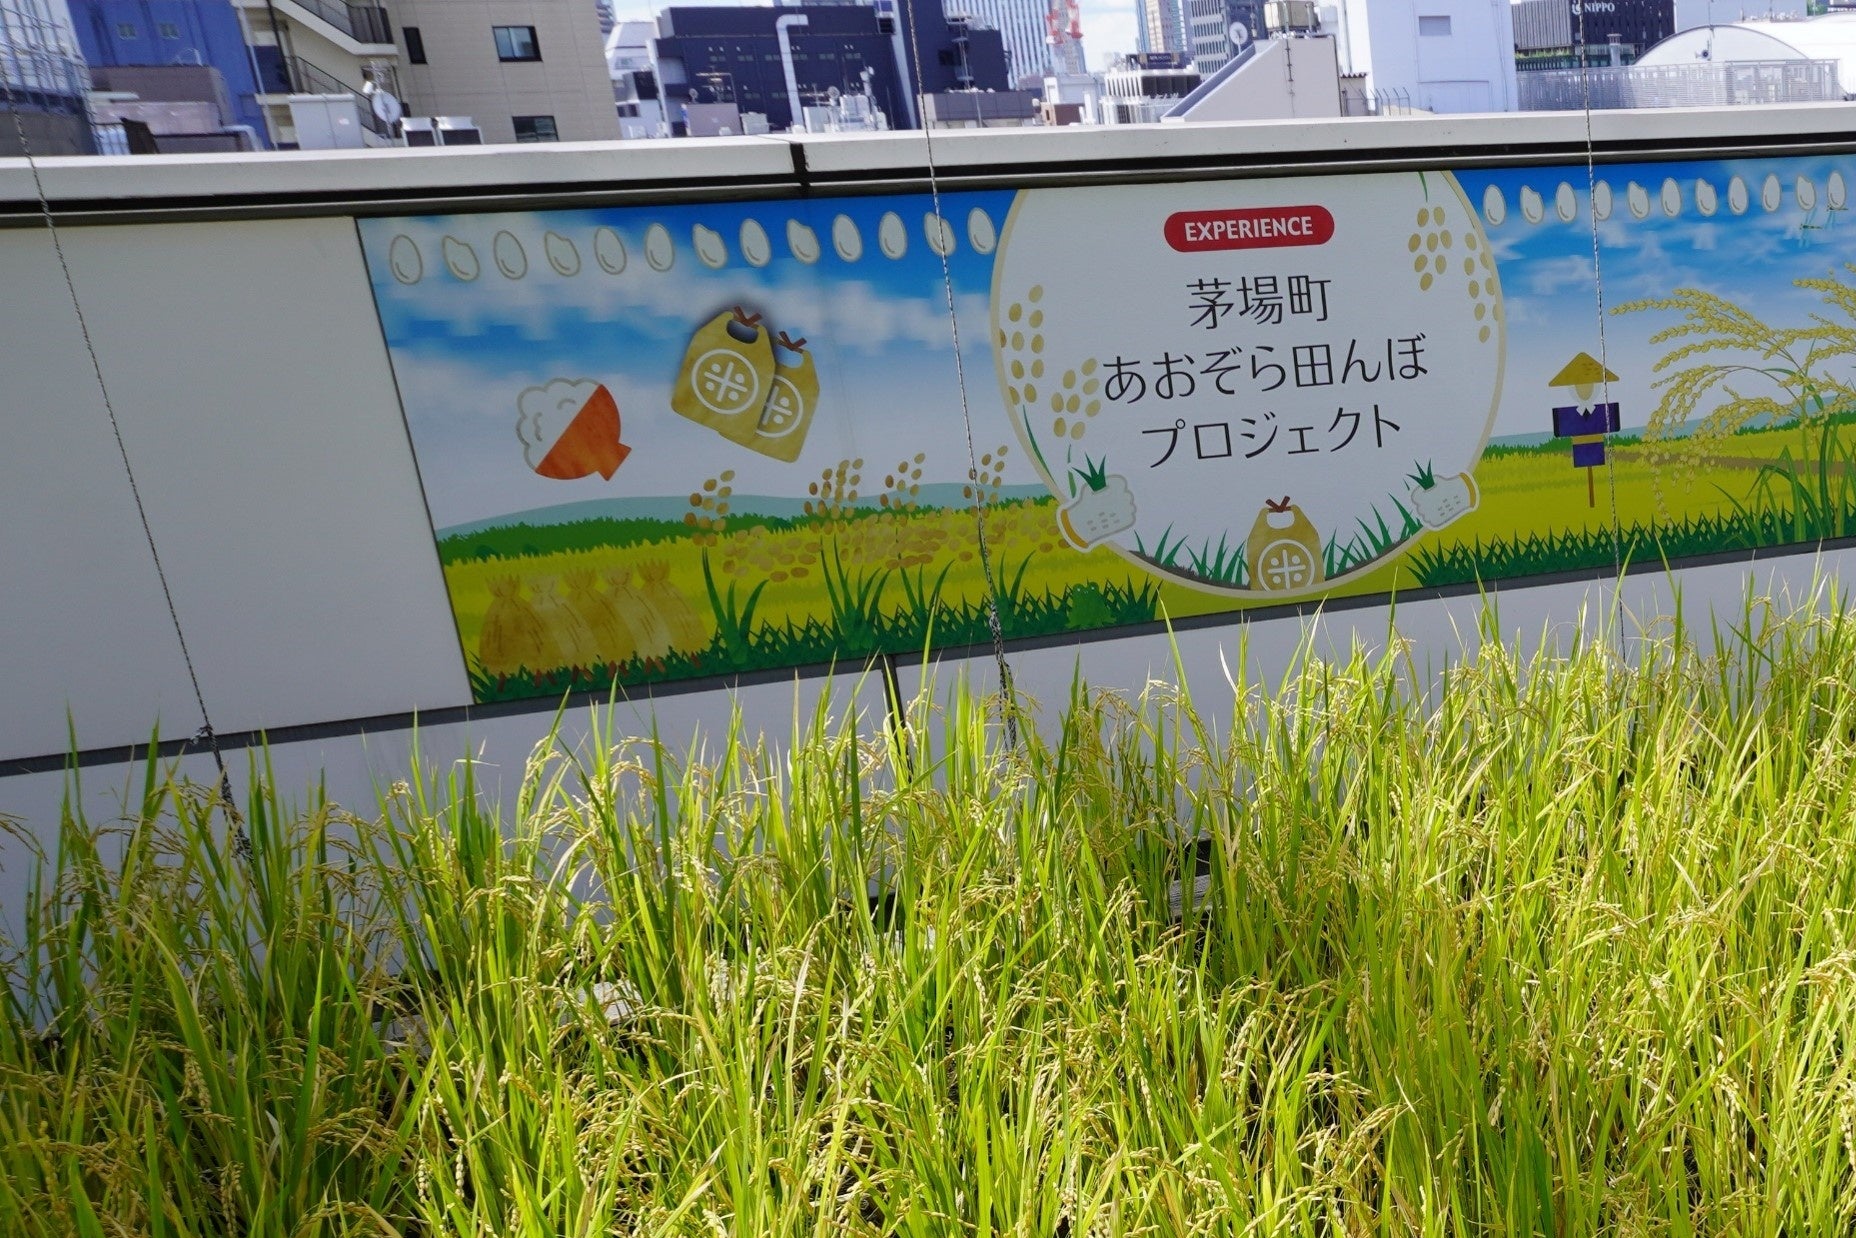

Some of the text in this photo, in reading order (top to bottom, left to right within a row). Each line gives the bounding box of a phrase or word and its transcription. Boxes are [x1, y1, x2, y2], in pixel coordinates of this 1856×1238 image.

[1584, 2, 1616, 13] NIPPO
[1184, 216, 1314, 242] EXPERIENCE
[1186, 275, 1332, 330] 茅場町
[1102, 332, 1428, 404] あおぞら田んぼ
[1141, 404, 1401, 468] プロジェクト
